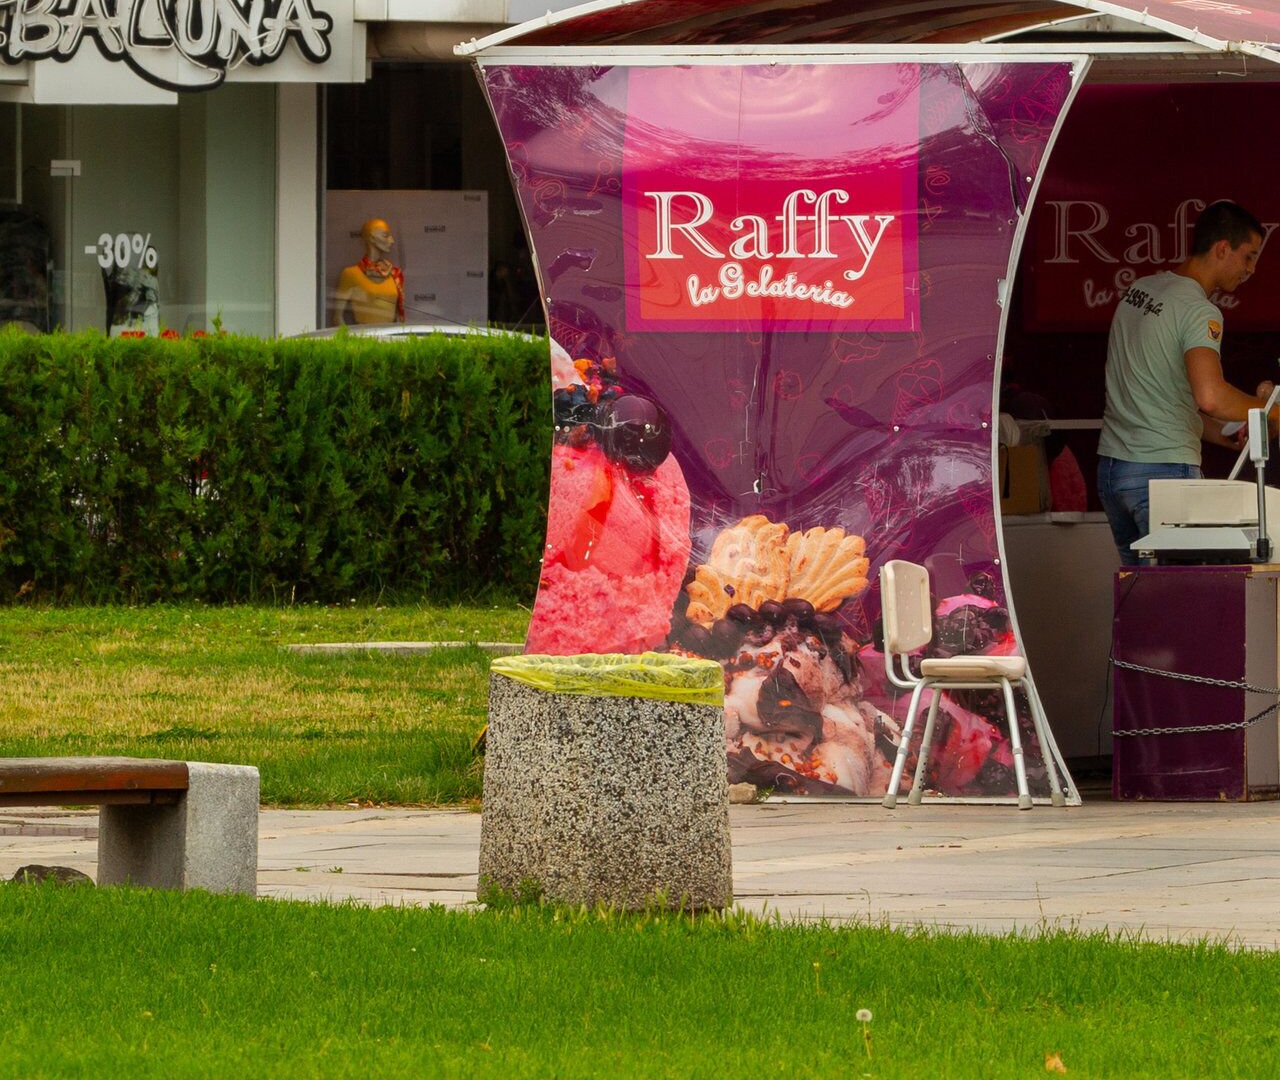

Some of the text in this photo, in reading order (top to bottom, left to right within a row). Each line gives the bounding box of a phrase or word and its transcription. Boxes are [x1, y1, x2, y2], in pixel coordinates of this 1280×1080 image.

[84, 233, 158, 269] -30%
[644, 188, 895, 280] Raffy
[686, 262, 854, 308] la Gelateria
